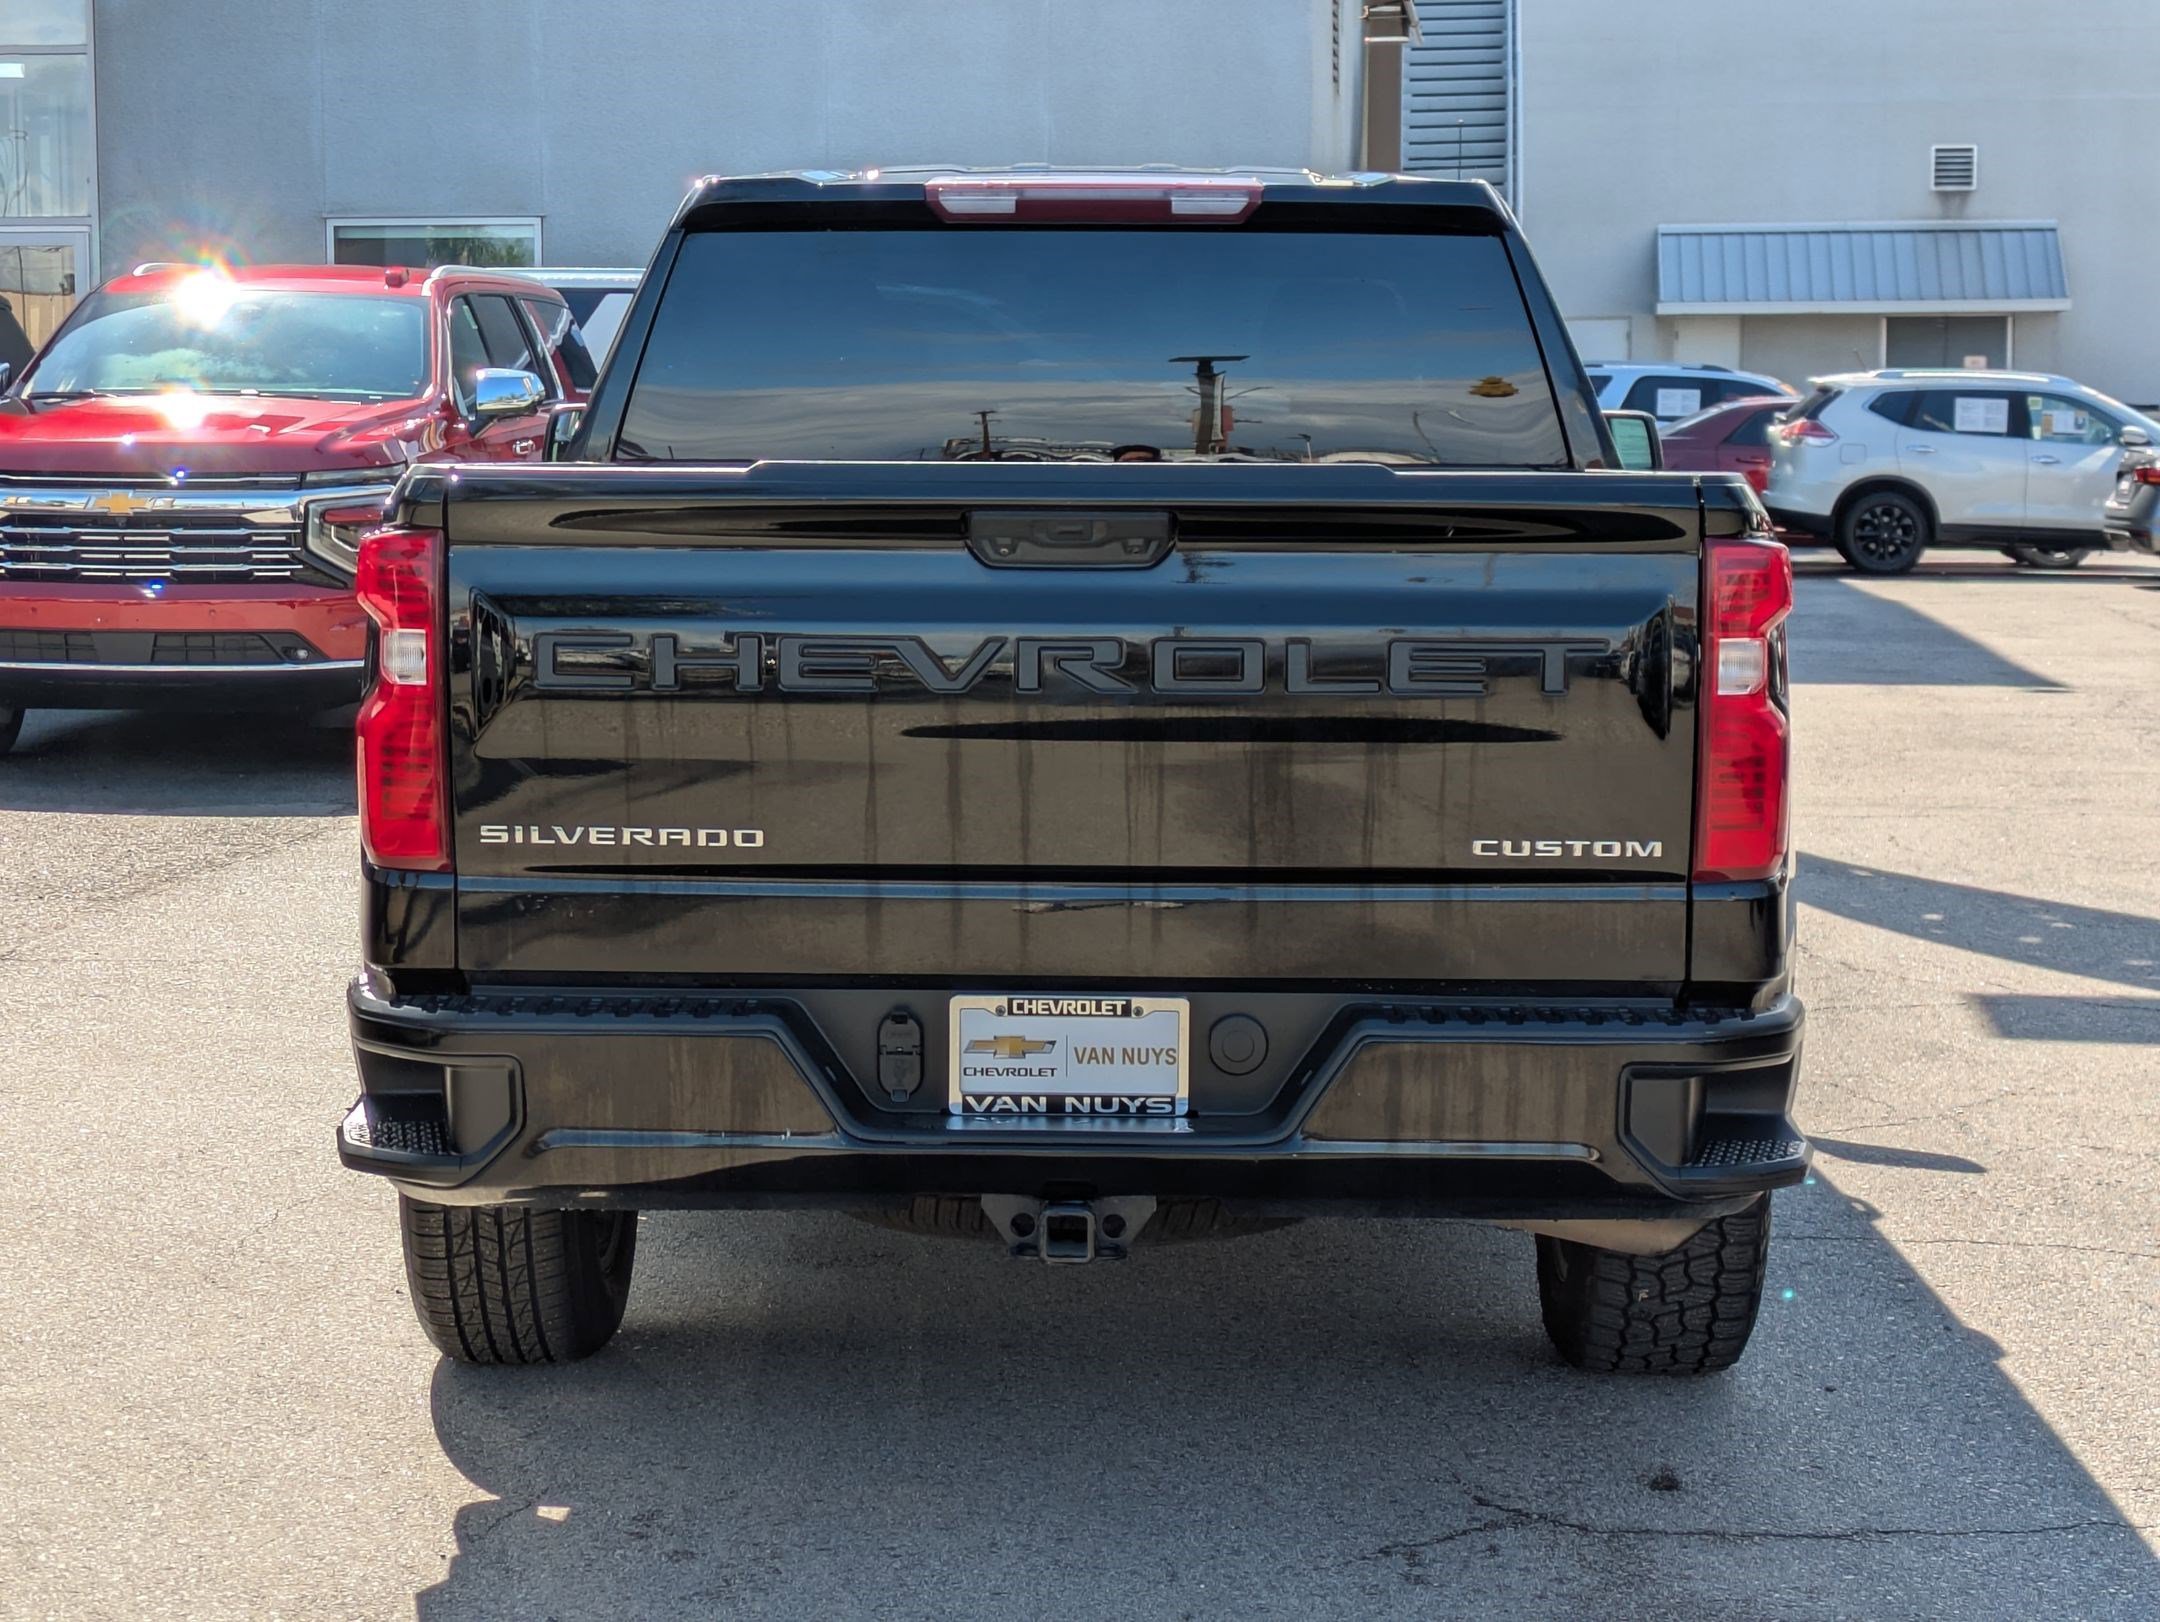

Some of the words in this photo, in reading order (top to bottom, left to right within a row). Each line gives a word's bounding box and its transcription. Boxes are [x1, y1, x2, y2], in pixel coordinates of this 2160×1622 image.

[535, 632, 1610, 693] CHEVROLET
[479, 825, 764, 848] SILVERADO
[1472, 840, 1662, 857] CUSTOM
[1012, 999, 1126, 1015] CHEVROLET
[1074, 1047, 1115, 1066] VAN
[1122, 1048, 1177, 1066] NUYS
[963, 1067, 1057, 1077] CHEVROLET
[965, 1096, 1047, 1113] VAN
[1065, 1097, 1173, 1114] NUYS
